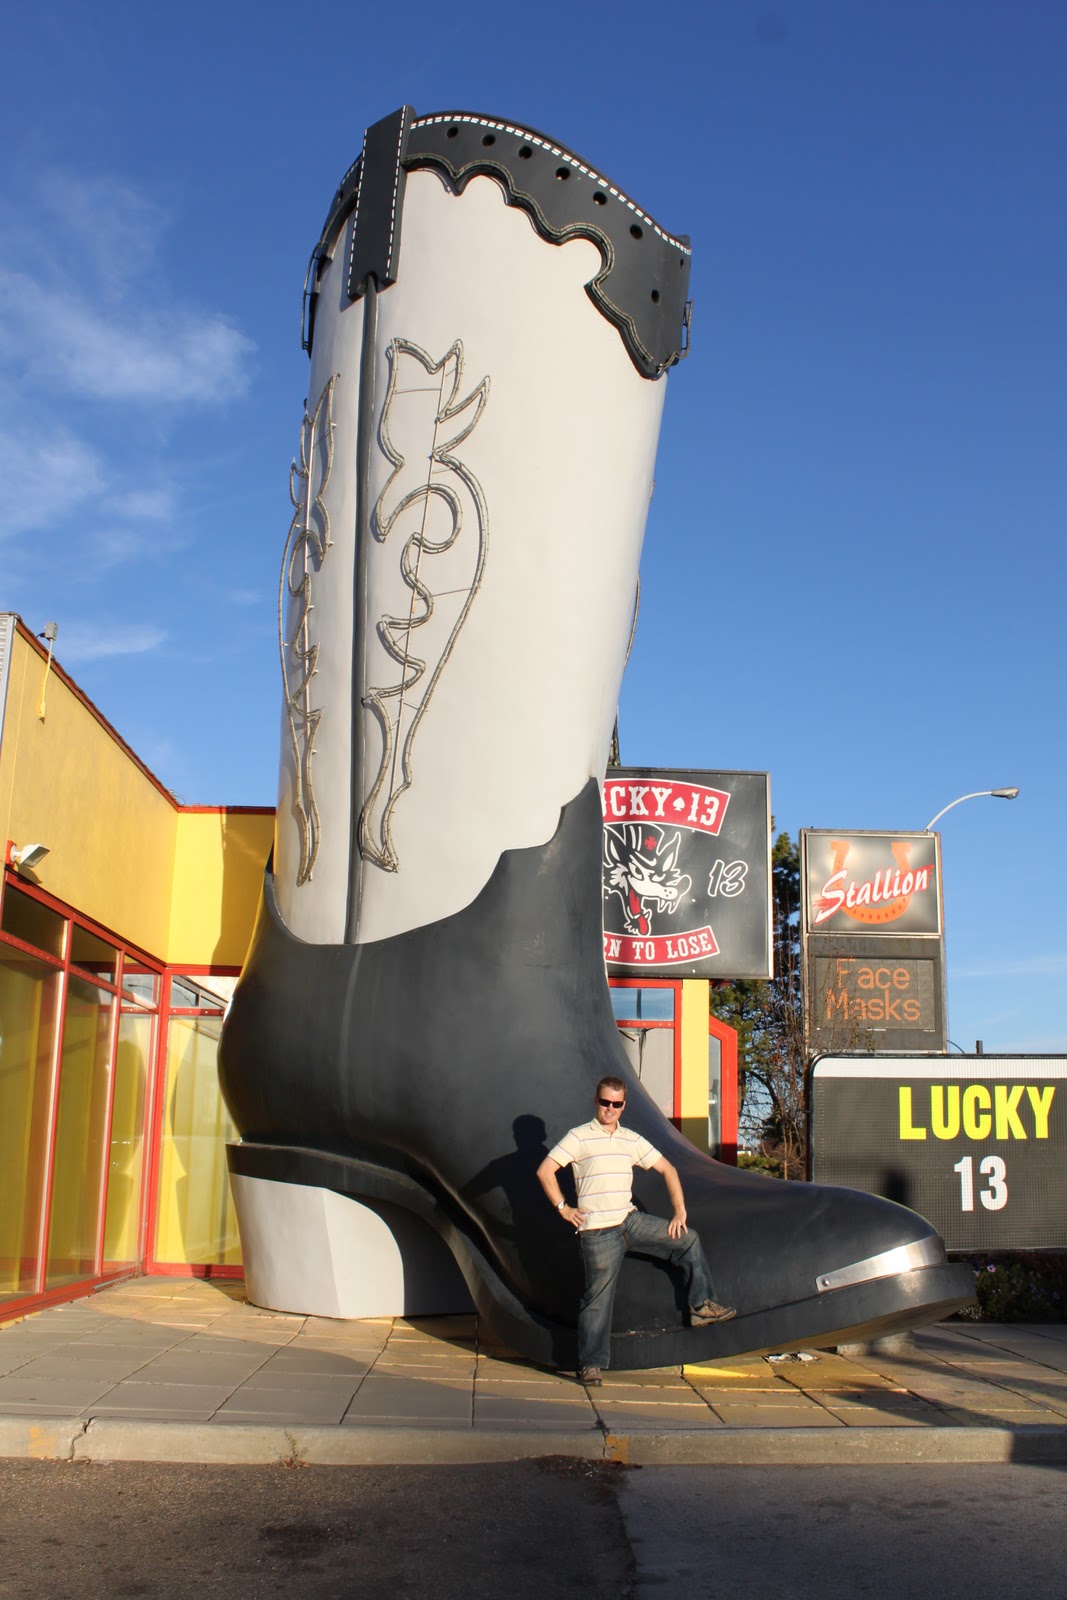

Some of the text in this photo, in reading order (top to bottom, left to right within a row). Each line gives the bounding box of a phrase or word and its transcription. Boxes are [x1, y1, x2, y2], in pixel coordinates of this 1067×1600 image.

[687, 792, 720, 826] 13
[707, 859, 749, 897] 13
[814, 869, 928, 924] Stallion
[632, 941, 655, 960] TO
[665, 933, 712, 959] LOSE
[836, 957, 910, 989] Face
[826, 988, 921, 1021] Masks
[899, 1085, 1055, 1140] LUCKY
[954, 1156, 1008, 1212] 13
